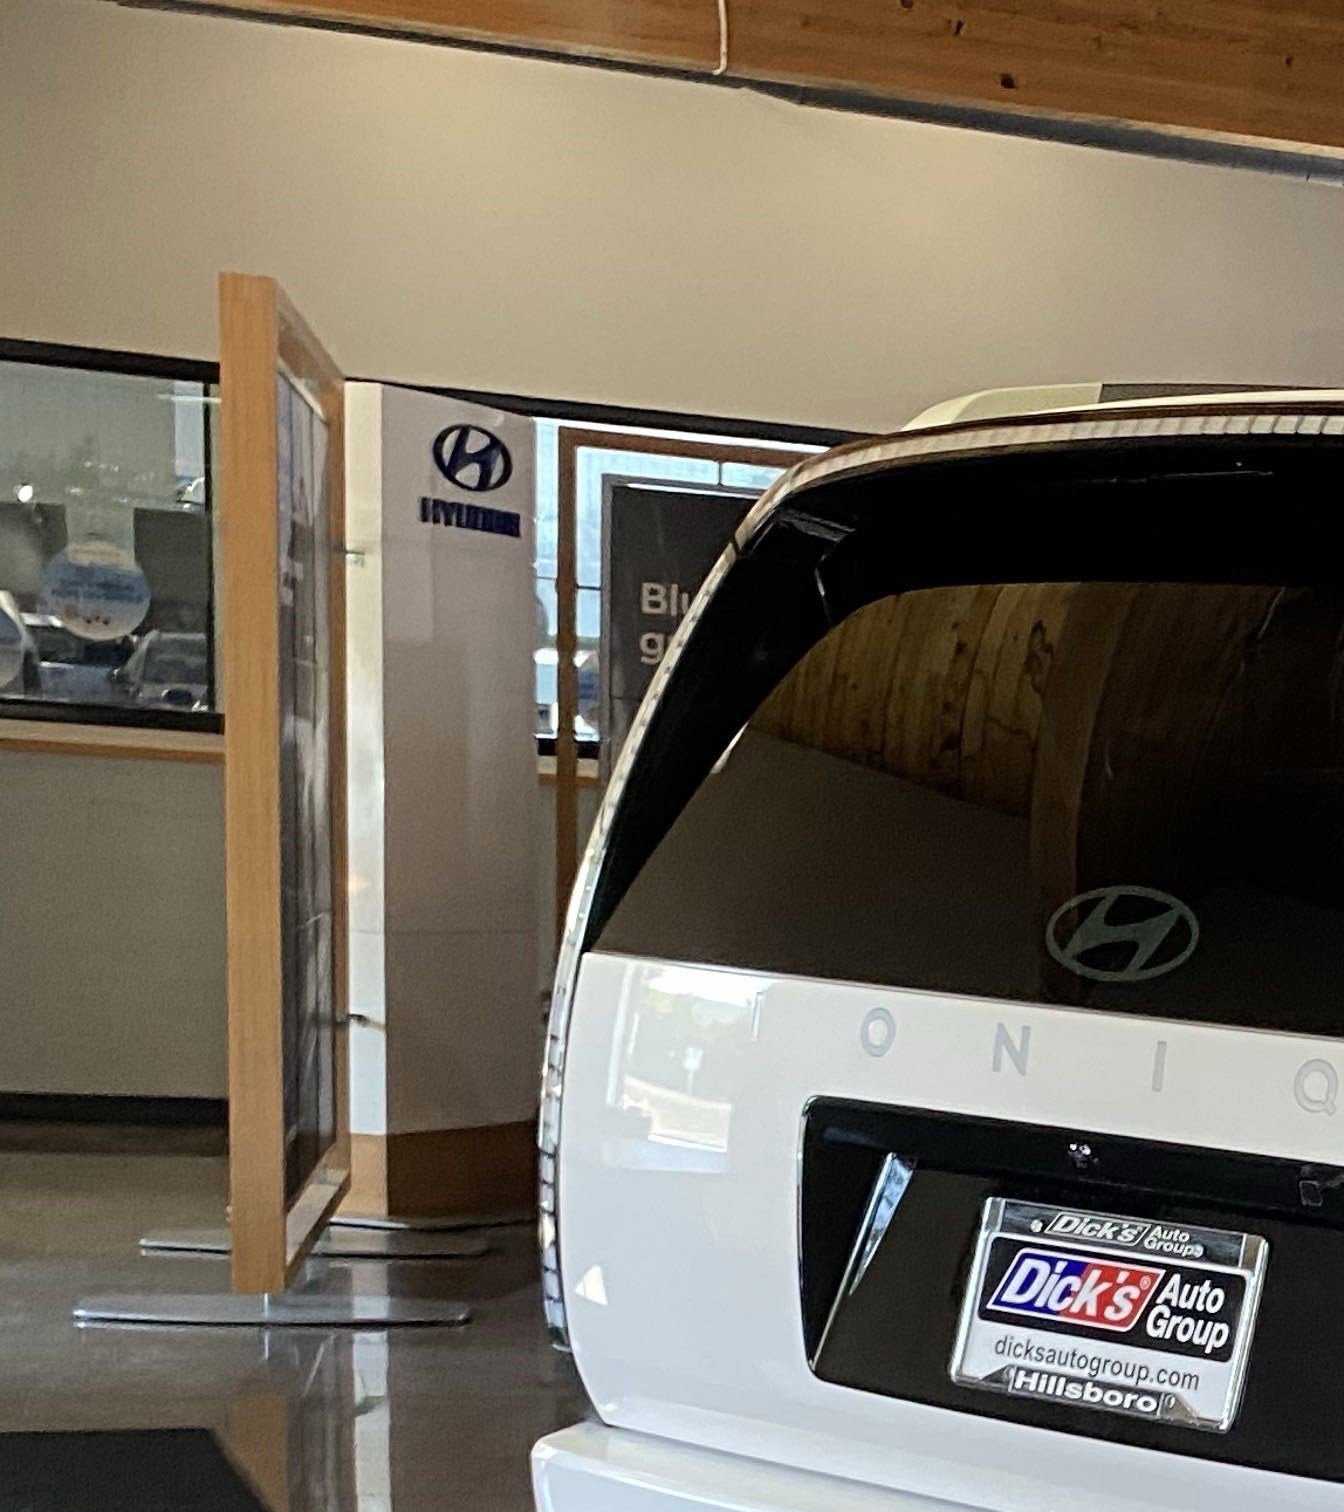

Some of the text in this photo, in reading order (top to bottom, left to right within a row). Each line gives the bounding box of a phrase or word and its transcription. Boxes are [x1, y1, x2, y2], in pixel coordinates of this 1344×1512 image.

[1052, 1213, 1144, 1244] Dick's
[1143, 1237, 1195, 1258] Group
[1149, 1225, 1191, 1242] Auto
[1155, 1273, 1226, 1315] Auto
[1145, 1304, 1230, 1355] Group
[994, 1335, 1200, 1392] dicksautogroup.com
[1014, 1366, 1159, 1413] Hillsboro
